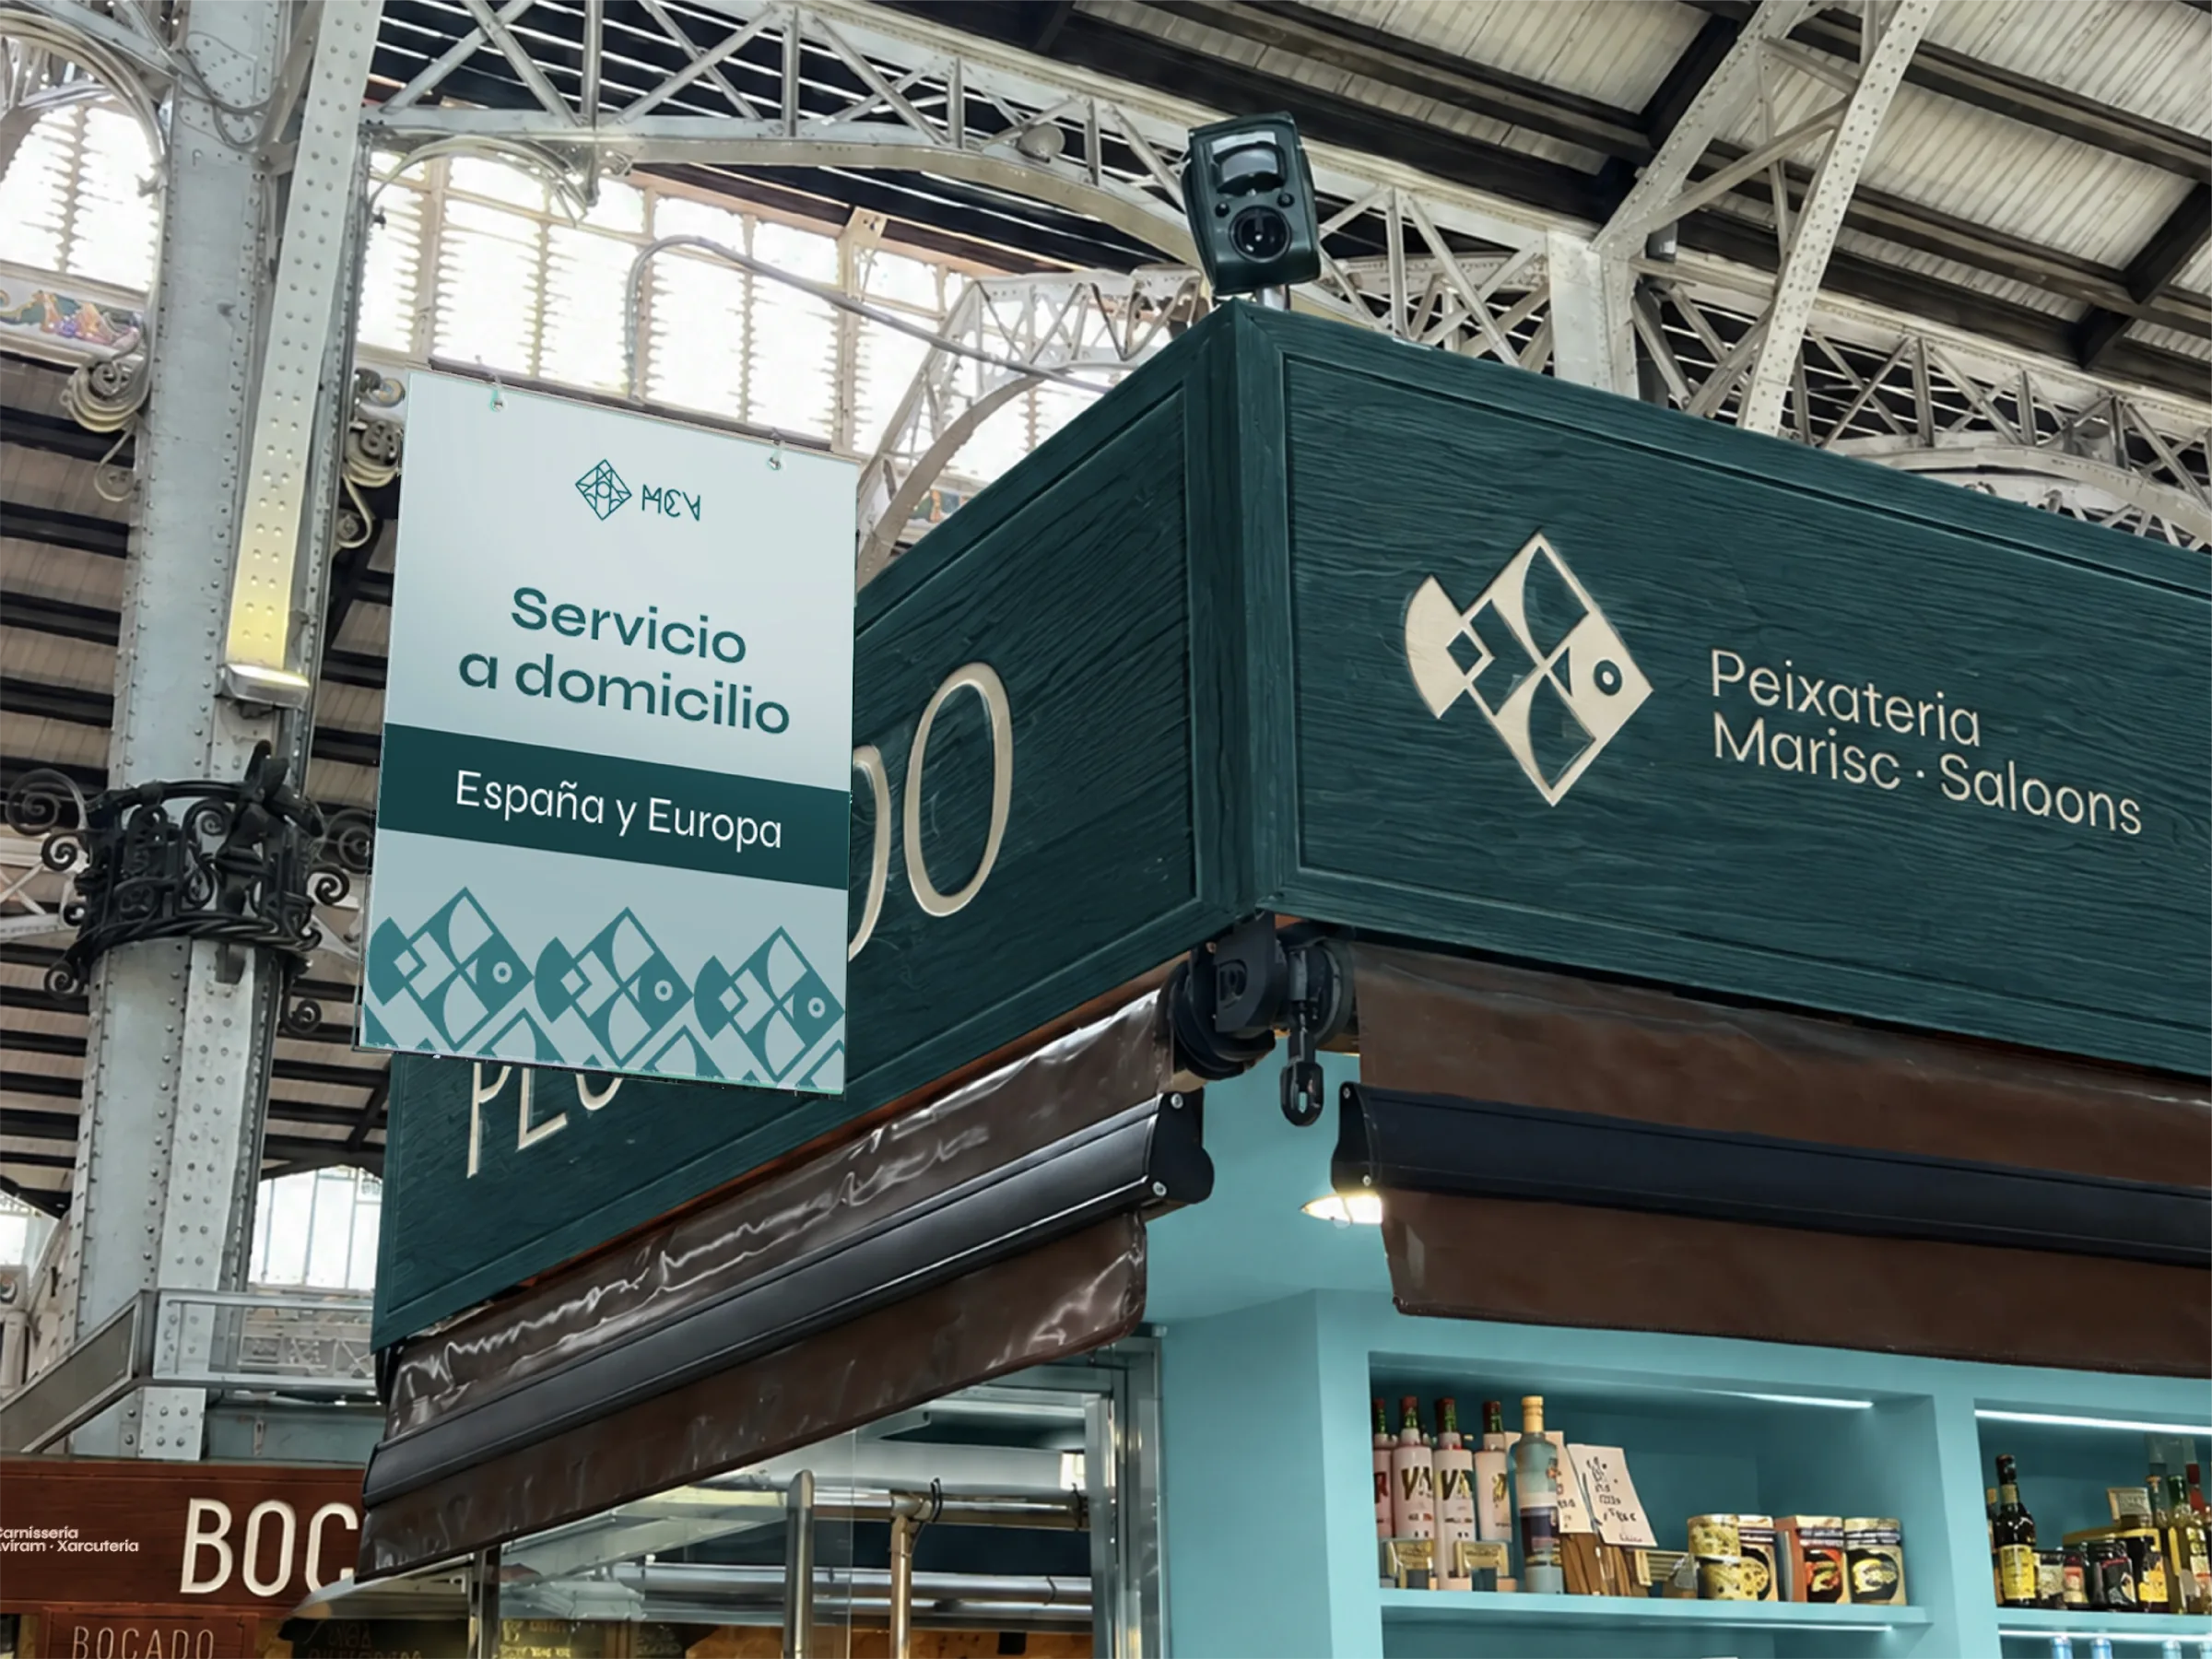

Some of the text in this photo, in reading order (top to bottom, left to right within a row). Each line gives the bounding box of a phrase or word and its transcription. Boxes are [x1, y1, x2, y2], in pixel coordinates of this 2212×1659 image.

[511, 586, 747, 664] Servicio
[459, 653, 790, 735] a domicilio
[1712, 649, 1980, 747] Peixateria
[456, 770, 782, 853] España y Europa
[1713, 712, 1900, 790] Marisc
[1939, 753, 2142, 835] Salaons
[0, 1538, 46, 1552] viram
[56, 1538, 139, 1552] Xarcuteria
[72, 1626, 214, 1659] BOCADO
